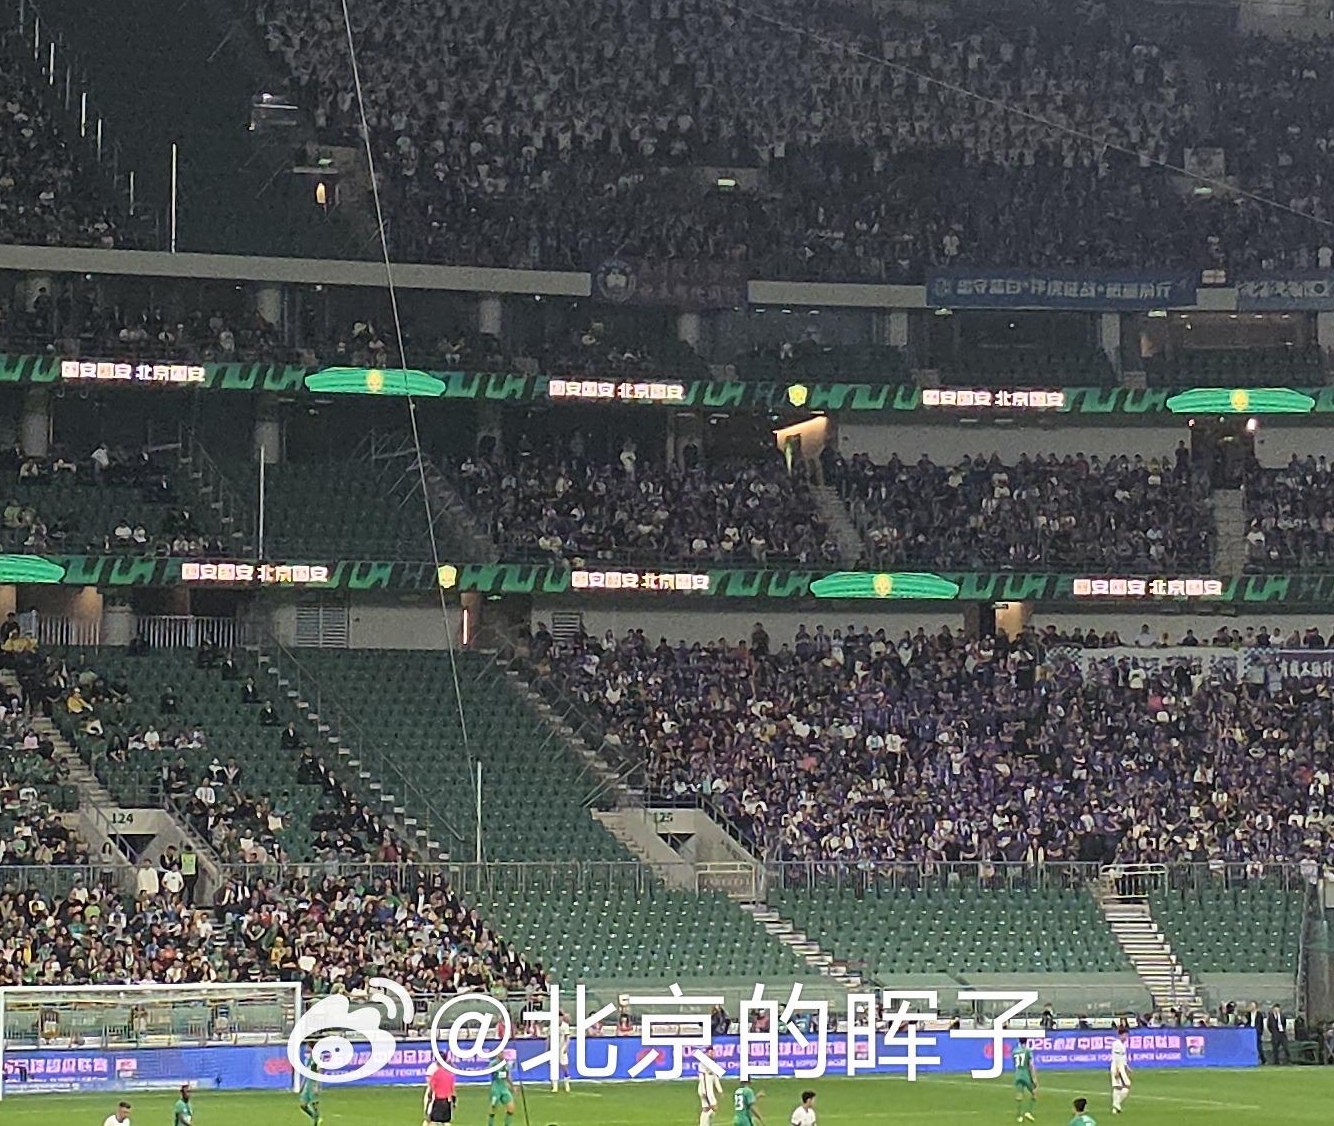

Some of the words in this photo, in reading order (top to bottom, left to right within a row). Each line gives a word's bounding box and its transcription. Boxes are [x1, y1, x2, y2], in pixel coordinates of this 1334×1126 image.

[62, 361, 131, 379] 国安国安
[136, 365, 205, 381] 北京国安
[549, 380, 615, 397] 国安国安
[617, 383, 685, 400] 北京国安
[923, 390, 992, 406] 国安国安
[995, 391, 1064, 407] 北京国安
[182, 563, 254, 580] 国安国安
[257, 565, 328, 582] 北京国安
[572, 571, 639, 588] 国安国安
[641, 573, 709, 589] 北京国安
[1074, 579, 1146, 595] 国安国安
[1149, 580, 1222, 595] 北京国安
[111, 813, 133, 823] 124
